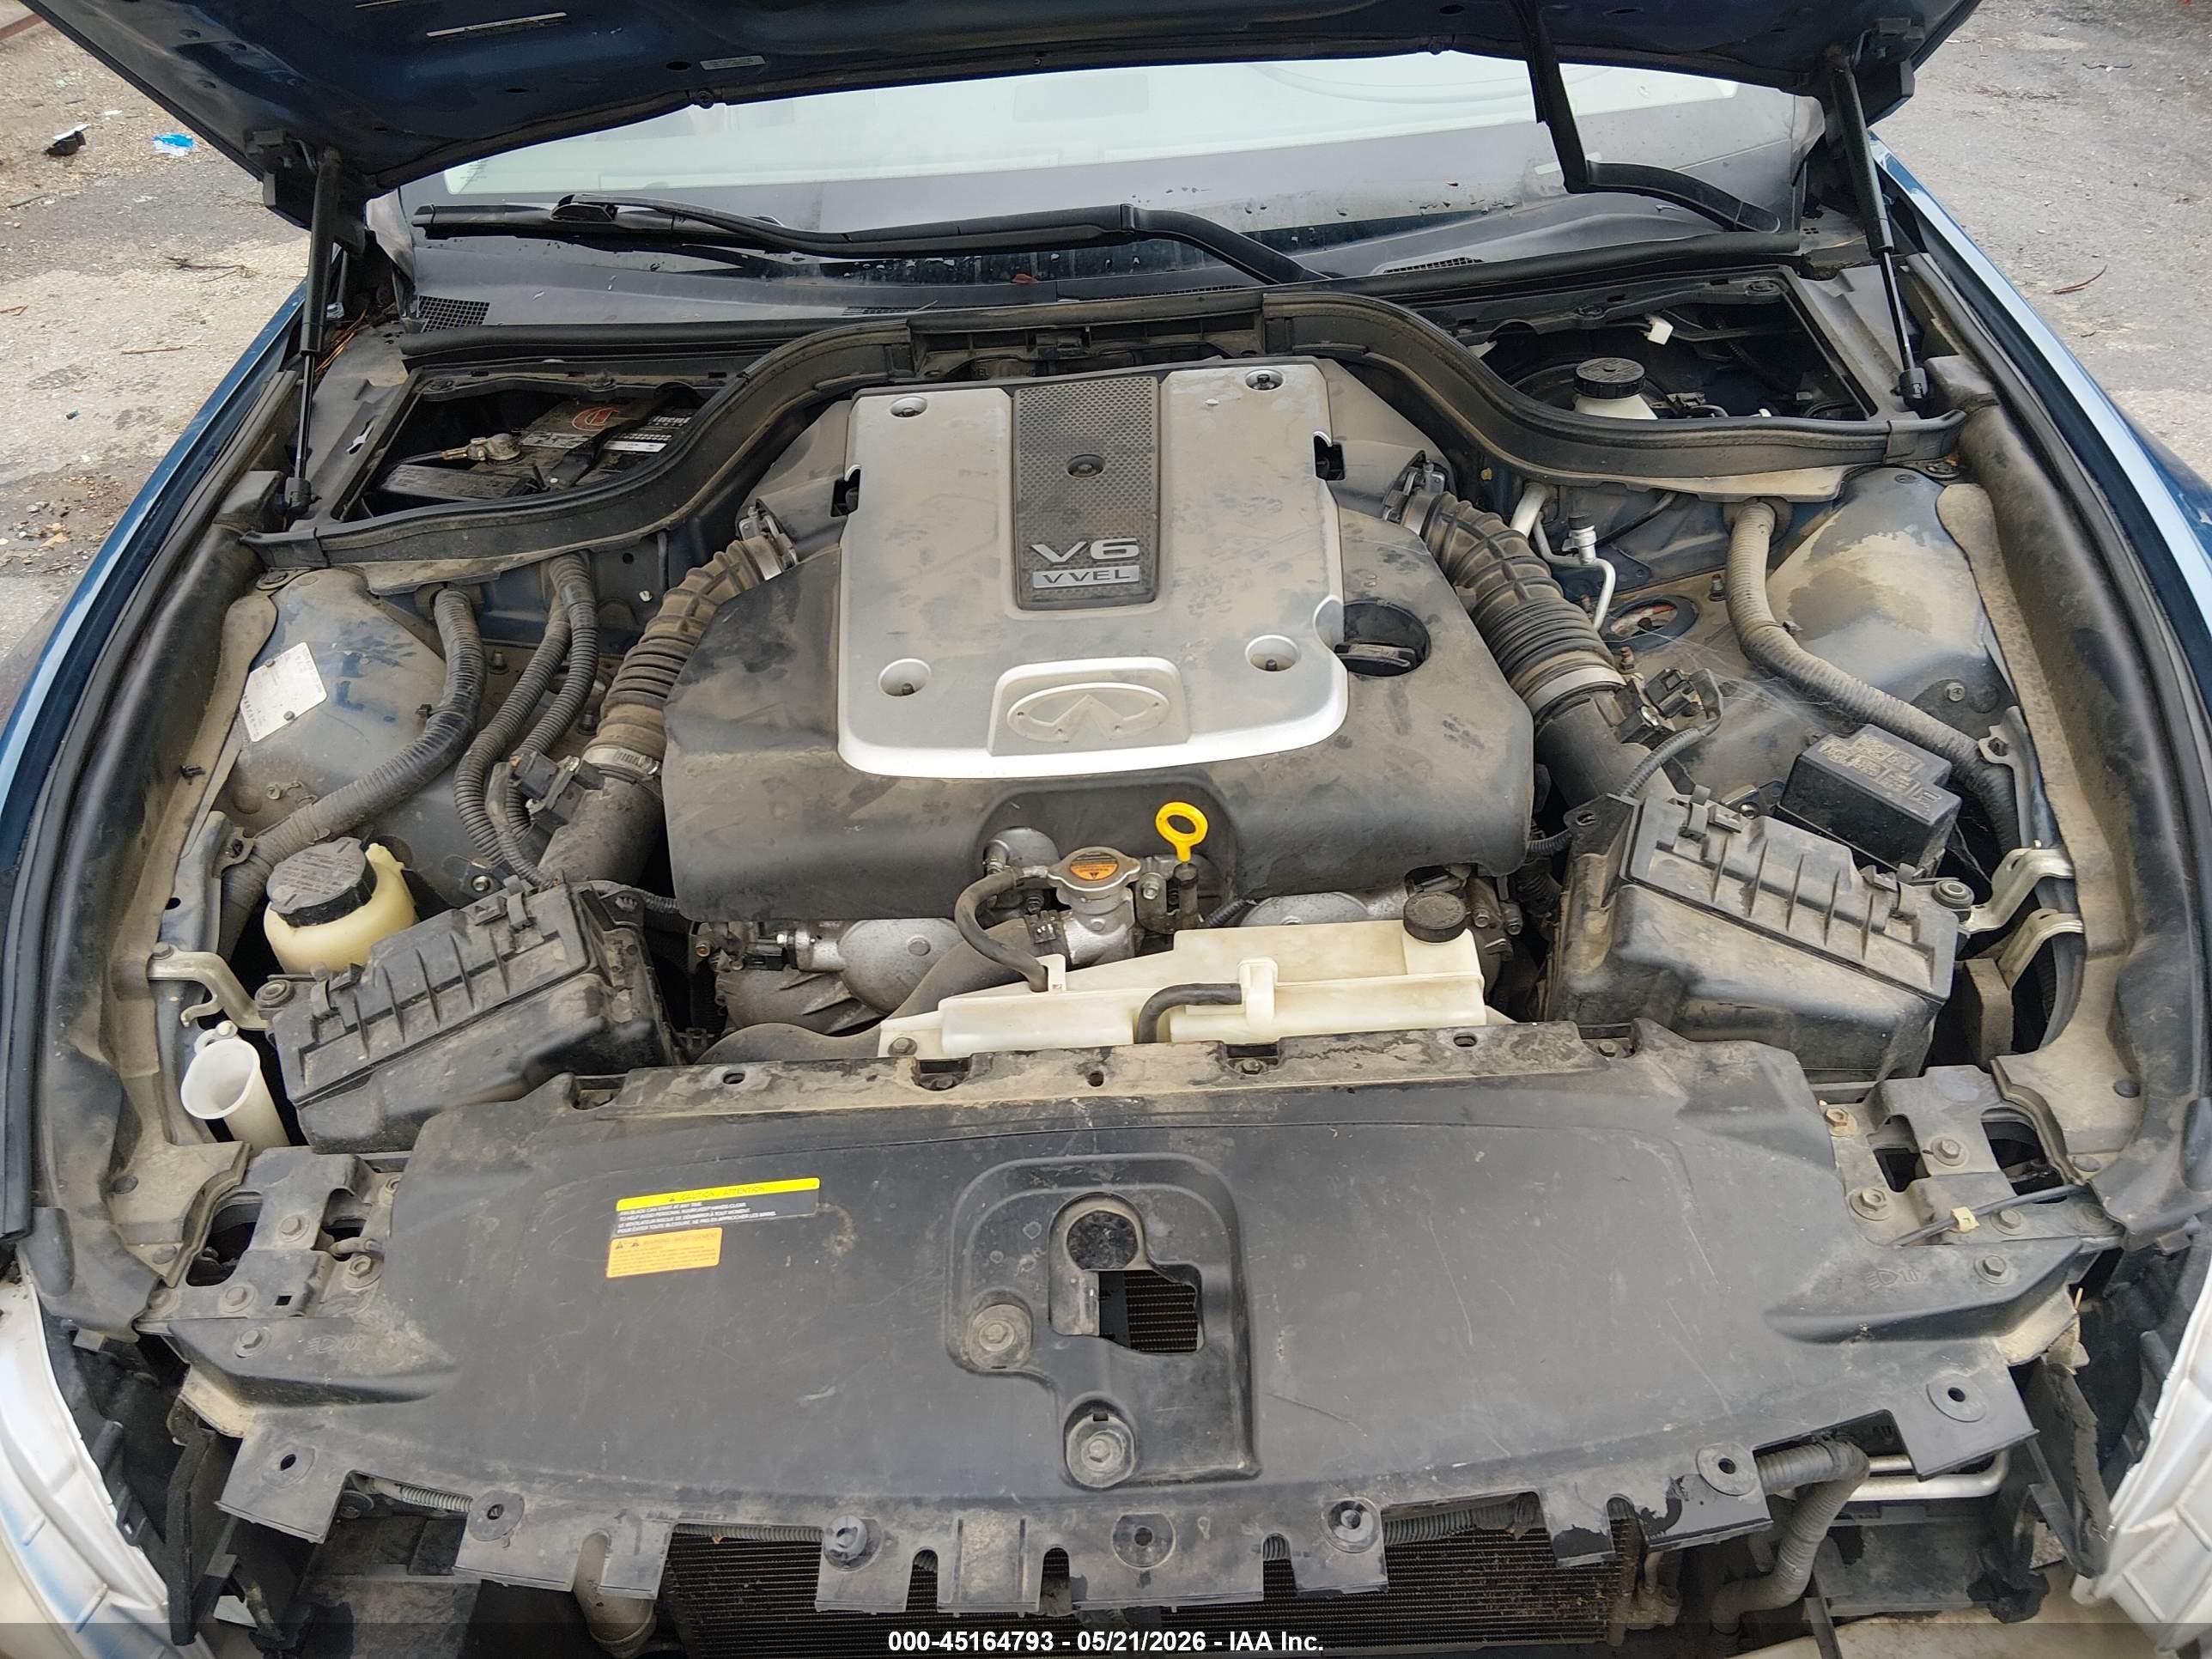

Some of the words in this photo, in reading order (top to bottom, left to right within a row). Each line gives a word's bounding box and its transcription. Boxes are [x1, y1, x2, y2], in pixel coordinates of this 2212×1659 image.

[1031, 538, 1140, 563] V6
[1042, 569, 1131, 584] VVEL
[723, 1186, 764, 1196] ATTENTION
